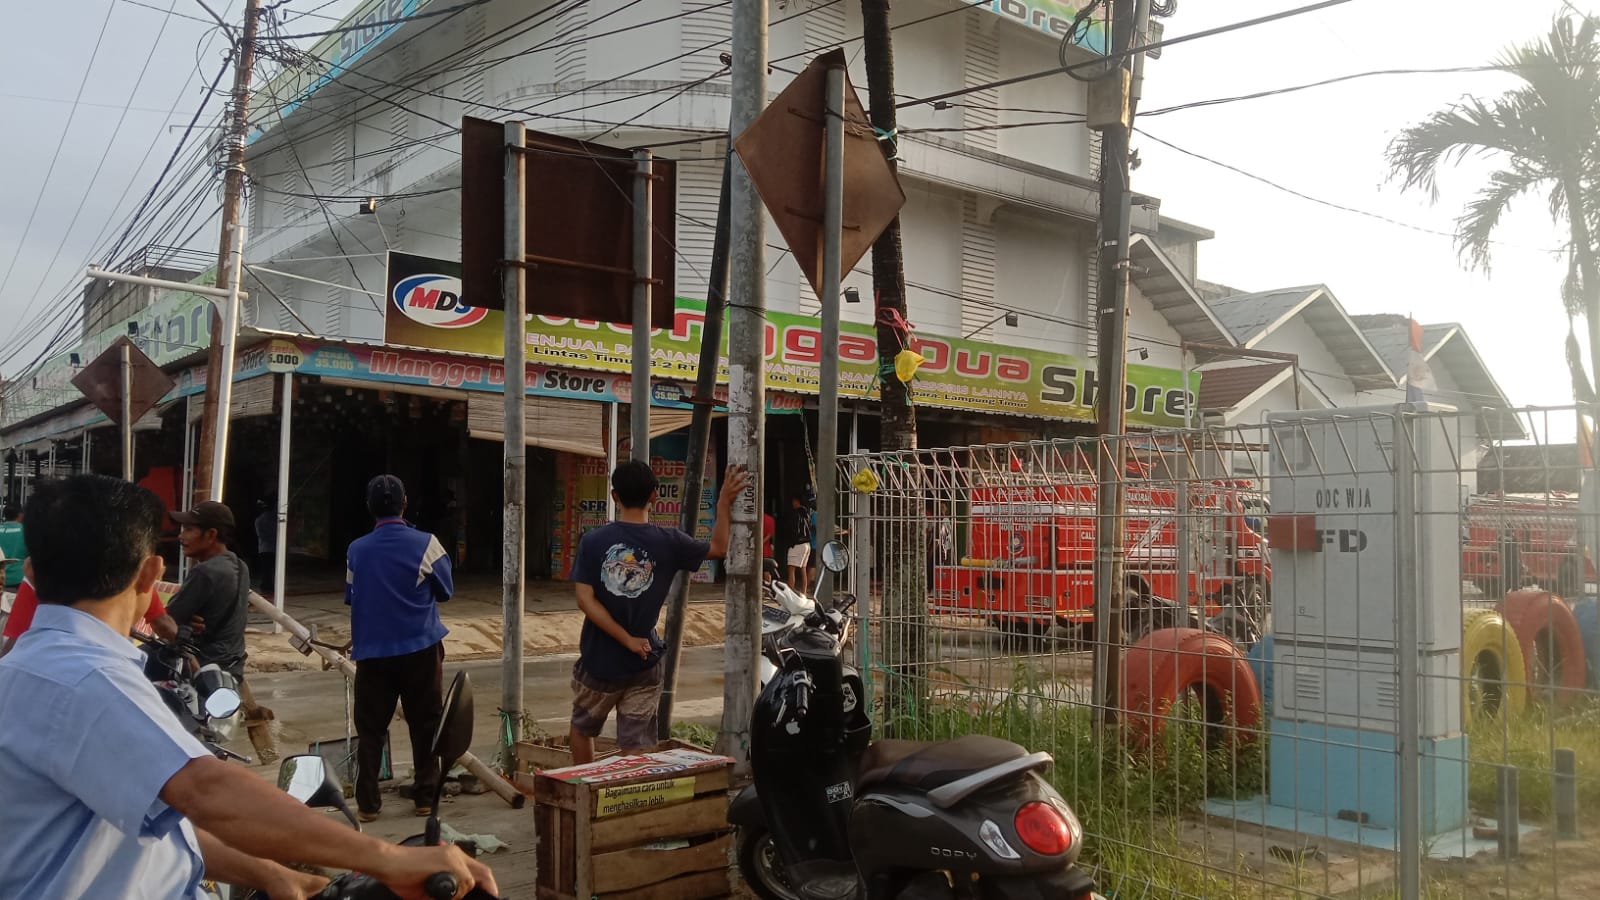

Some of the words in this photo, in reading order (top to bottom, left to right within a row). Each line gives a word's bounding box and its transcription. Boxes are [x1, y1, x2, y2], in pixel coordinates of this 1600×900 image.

[982, 0, 1071, 36] ore
[527, 333, 609, 352] ENJUAL
[614, 343, 700, 363] PAAIAN
[534, 347, 588, 360] Lintas
[593, 353, 632, 364] Timu
[796, 376, 819, 385] Bra
[908, 336, 1031, 382] Dua
[370, 351, 483, 388] Mangga
[488, 362, 538, 388] Da
[544, 369, 606, 393] Store
[603, 798, 648, 814] menghasilkan
[605, 785, 641, 799] Bagaimana
[641, 783, 656, 793] cara
[656, 779, 675, 791] untuk
